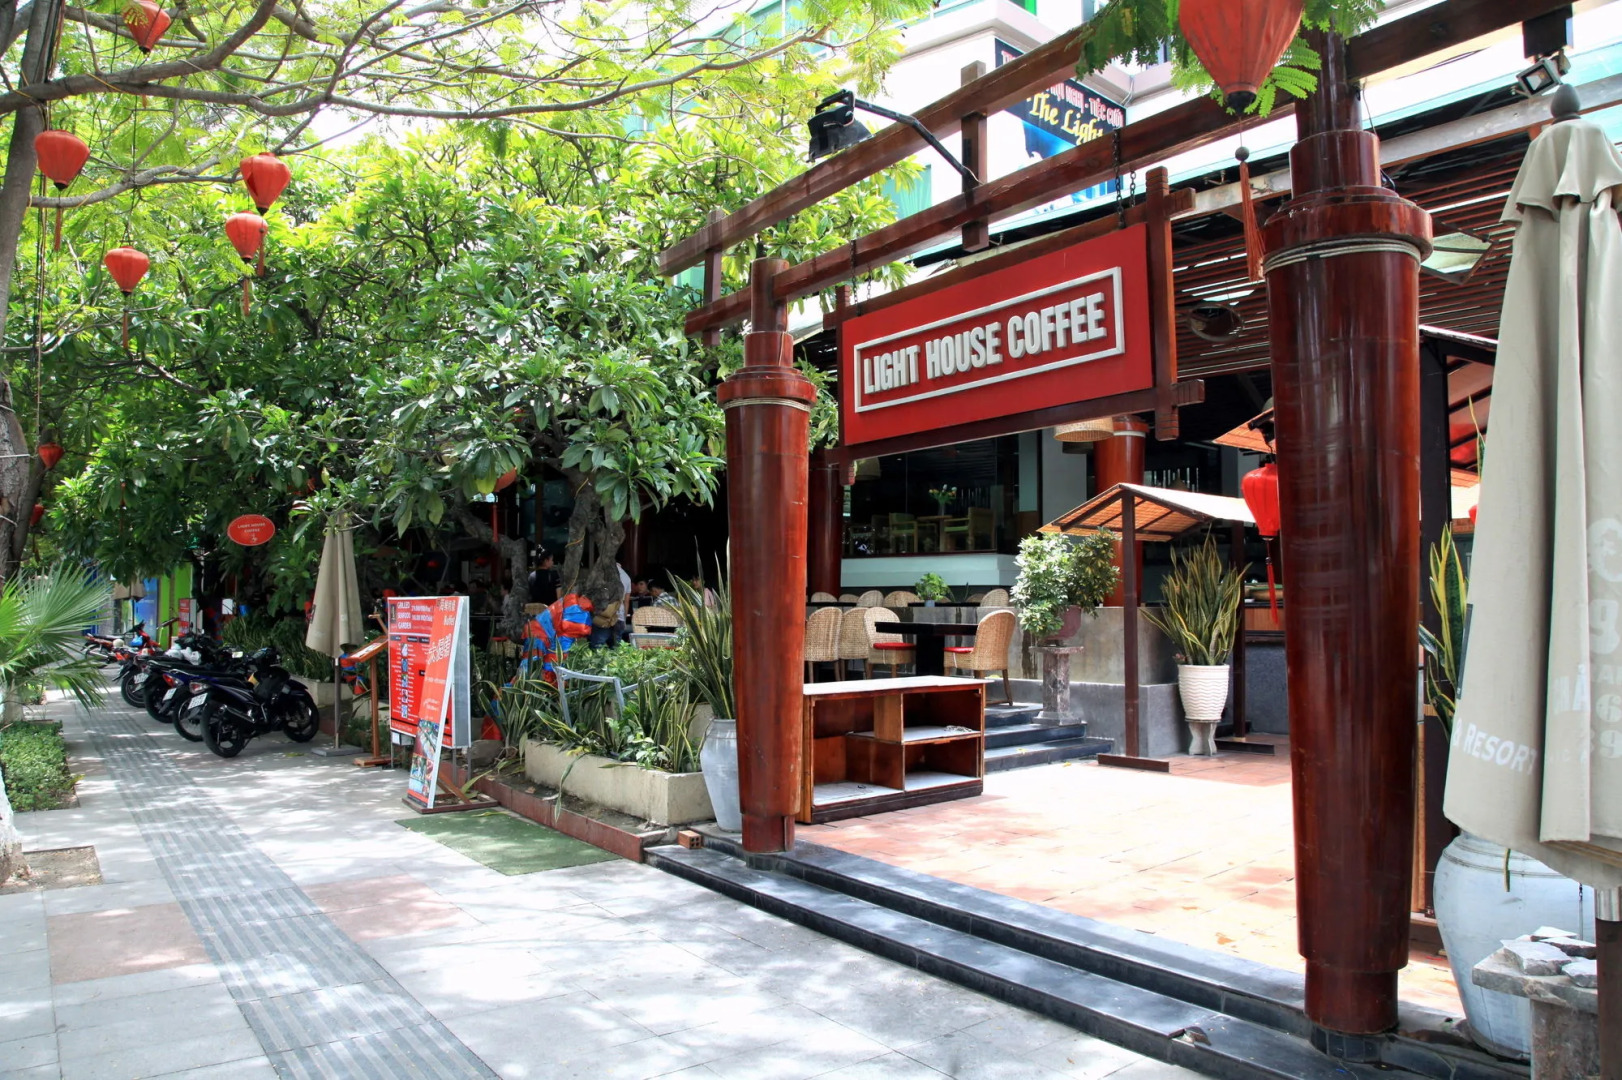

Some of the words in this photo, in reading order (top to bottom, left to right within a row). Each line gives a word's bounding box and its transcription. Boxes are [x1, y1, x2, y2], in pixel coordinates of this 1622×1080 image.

[1027, 92, 1059, 125] The
[864, 345, 920, 395] LIGHT
[925, 321, 1003, 380] HOUSE
[1007, 292, 1107, 359] COFFEE
